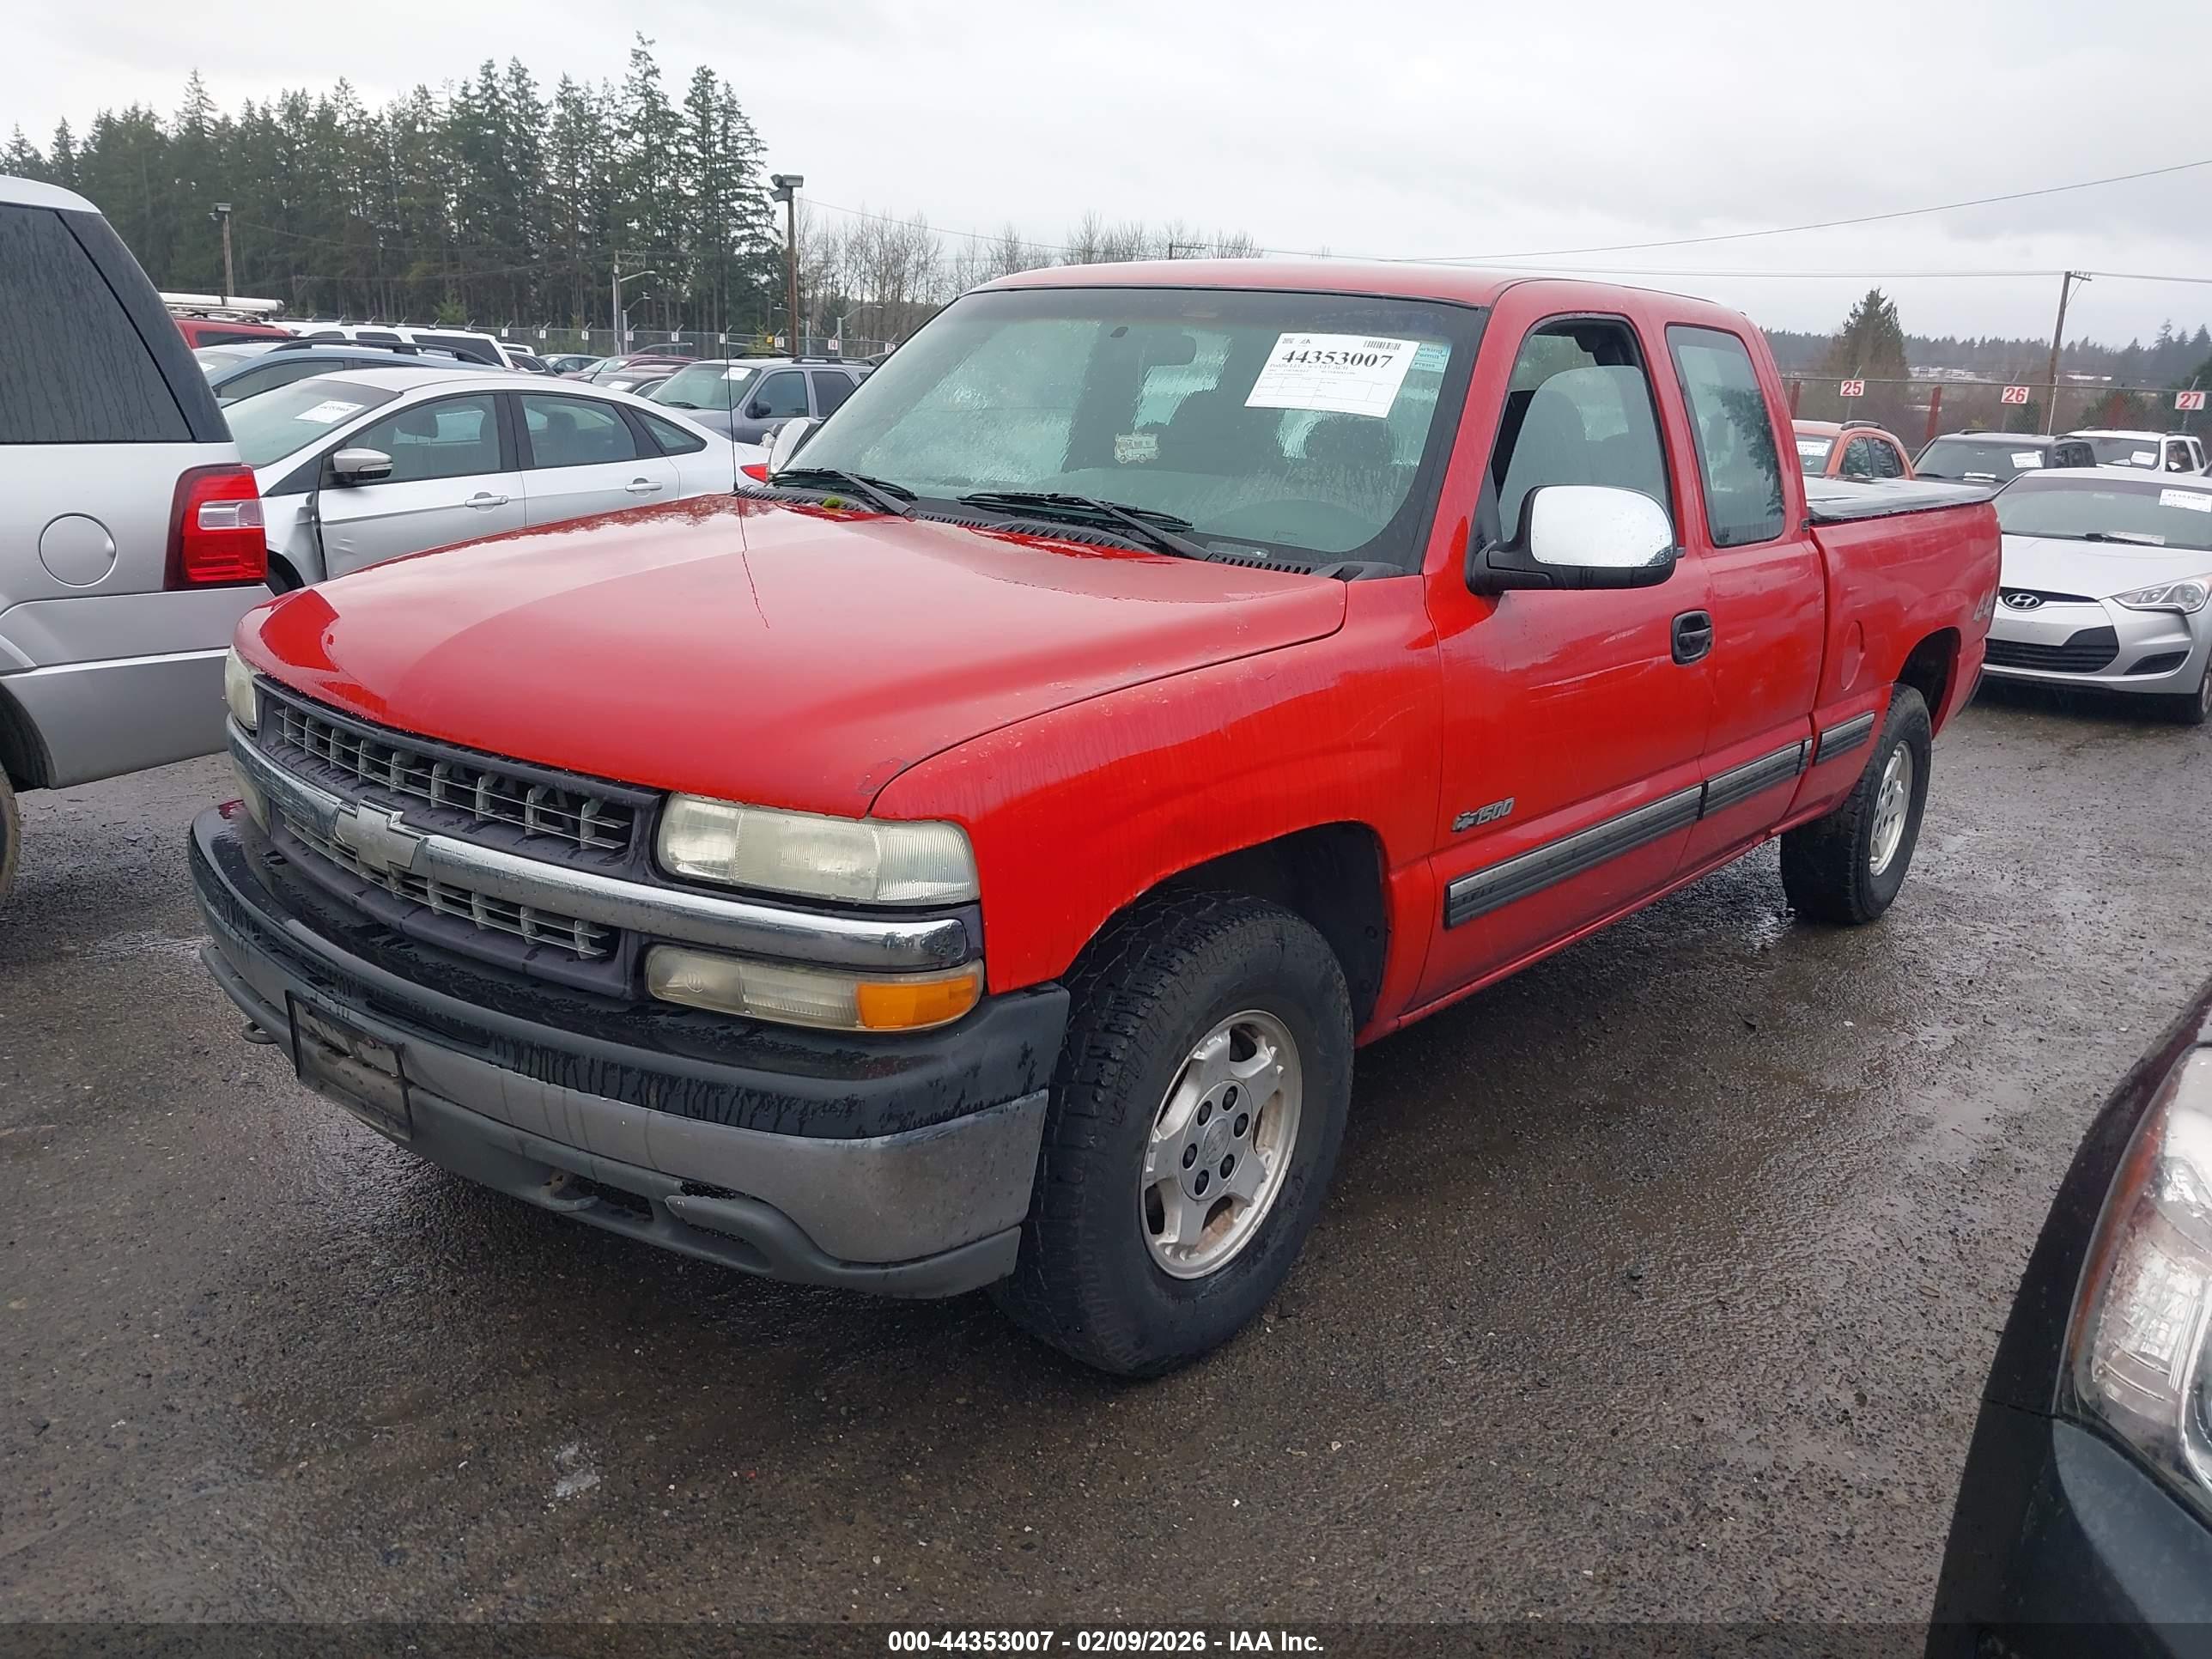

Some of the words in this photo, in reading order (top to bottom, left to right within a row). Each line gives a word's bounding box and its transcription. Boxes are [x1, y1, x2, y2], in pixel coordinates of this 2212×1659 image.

[1282, 350, 1394, 368] 44353007
[1842, 381, 1862, 395] 25
[2003, 387, 2026, 403] 26
[2179, 392, 2202, 408] 27
[1476, 797, 1516, 825] 1500
